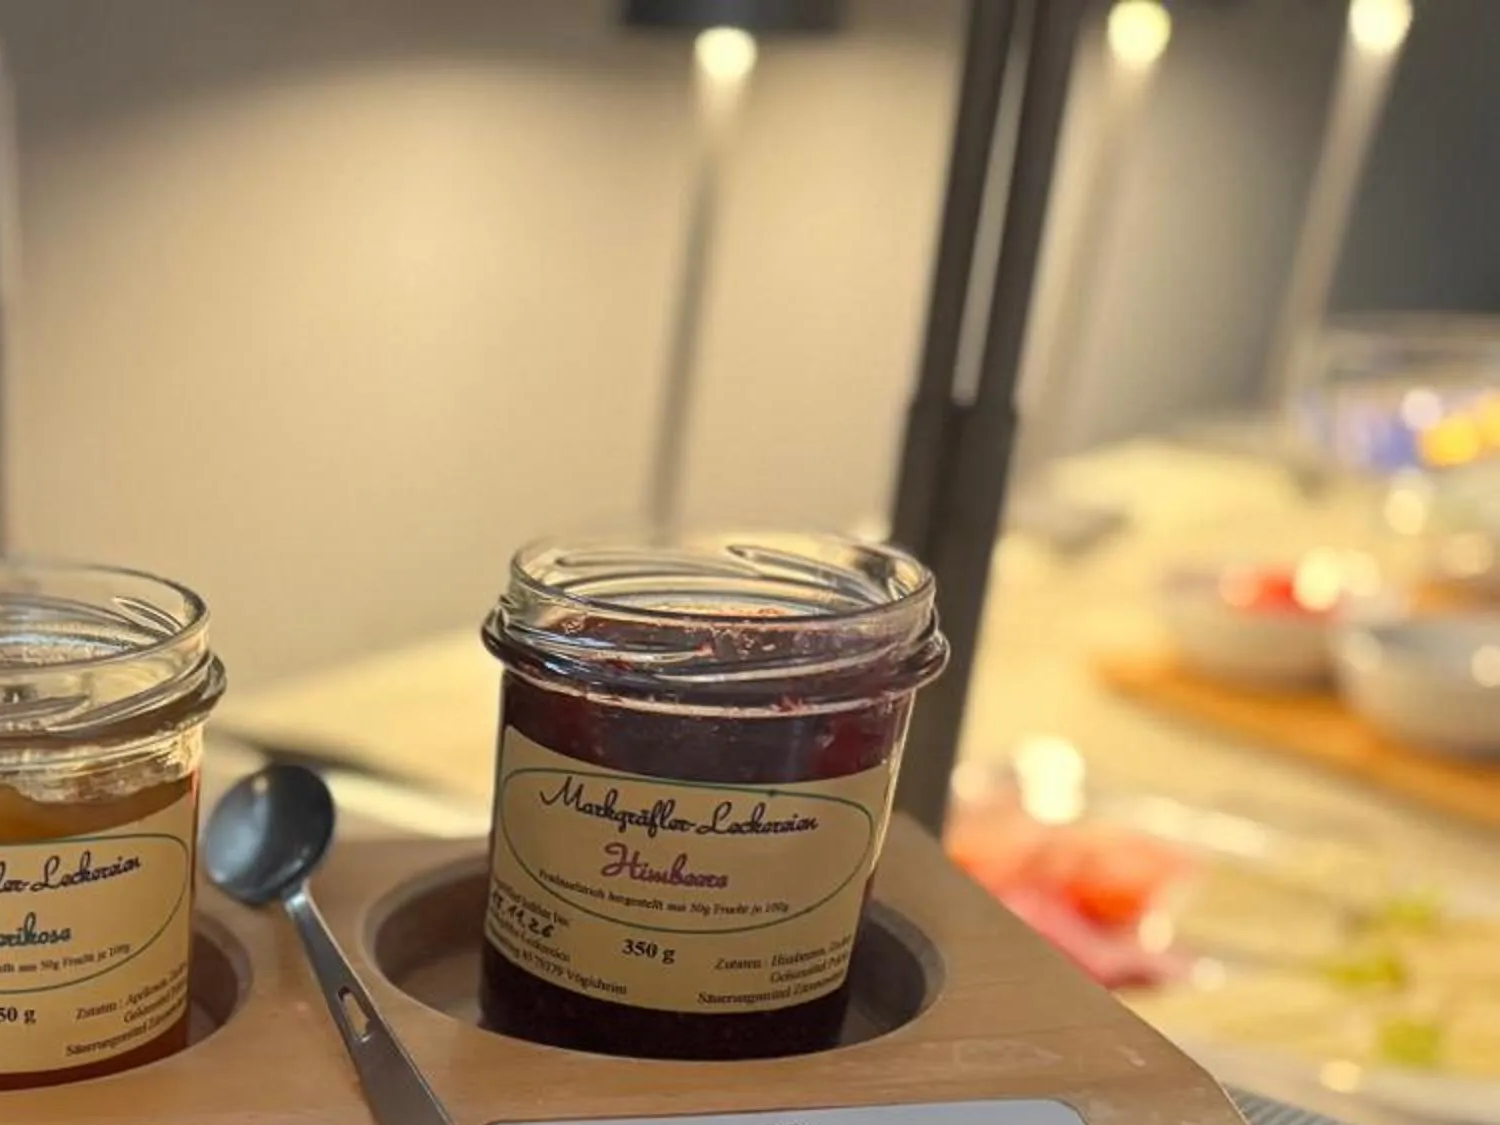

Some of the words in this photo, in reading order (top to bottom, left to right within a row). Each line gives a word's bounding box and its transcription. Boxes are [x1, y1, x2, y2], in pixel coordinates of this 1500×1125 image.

[601, 842, 729, 888] Himbeere
[621, 938, 658, 959] 350
[662, 949, 676, 965] g
[25, 1008, 37, 1025] g
